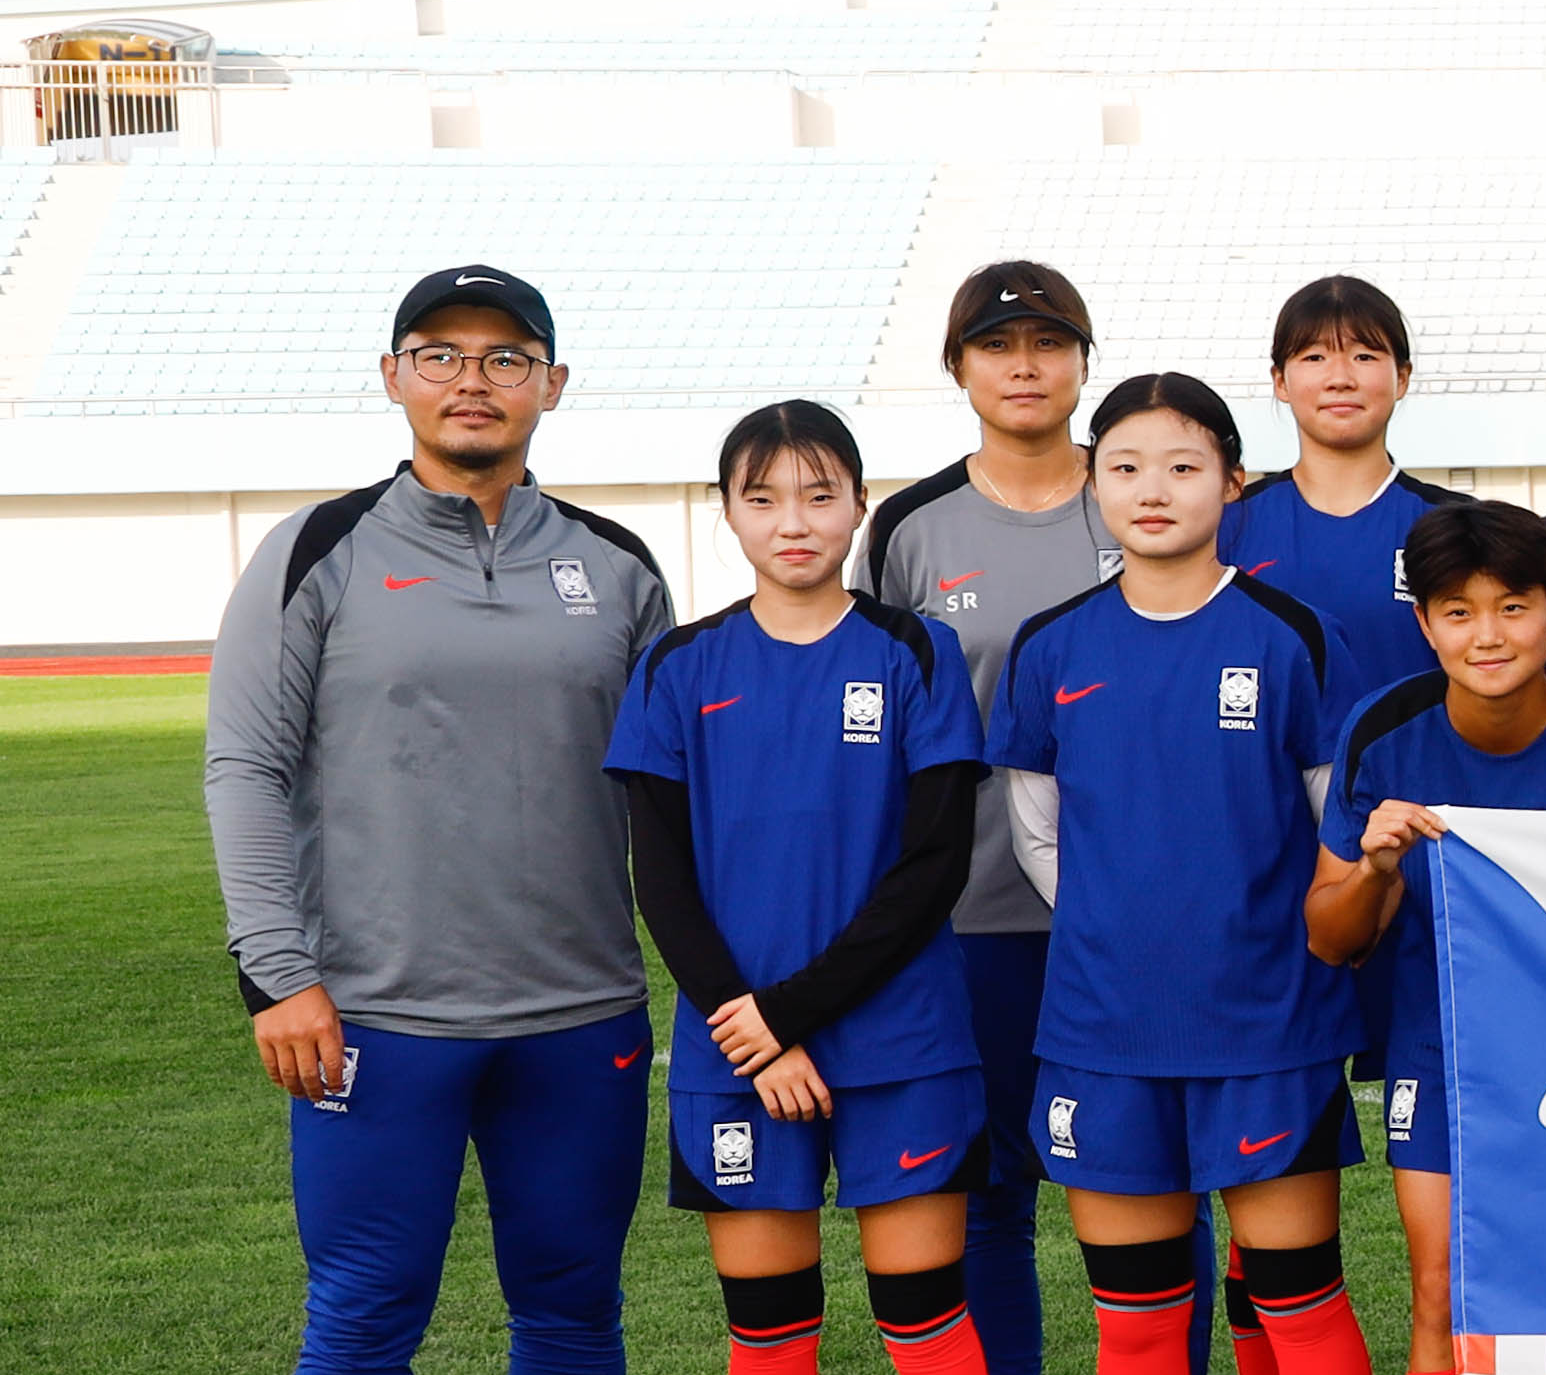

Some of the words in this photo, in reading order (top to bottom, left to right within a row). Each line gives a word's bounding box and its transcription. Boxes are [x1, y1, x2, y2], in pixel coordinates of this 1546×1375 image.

[946, 592, 978, 613] SR
[565, 606, 598, 616] KOREA
[1219, 719, 1256, 731] KOREA
[843, 732, 880, 744] KOREA
[716, 1173, 754, 1187] KOREA
